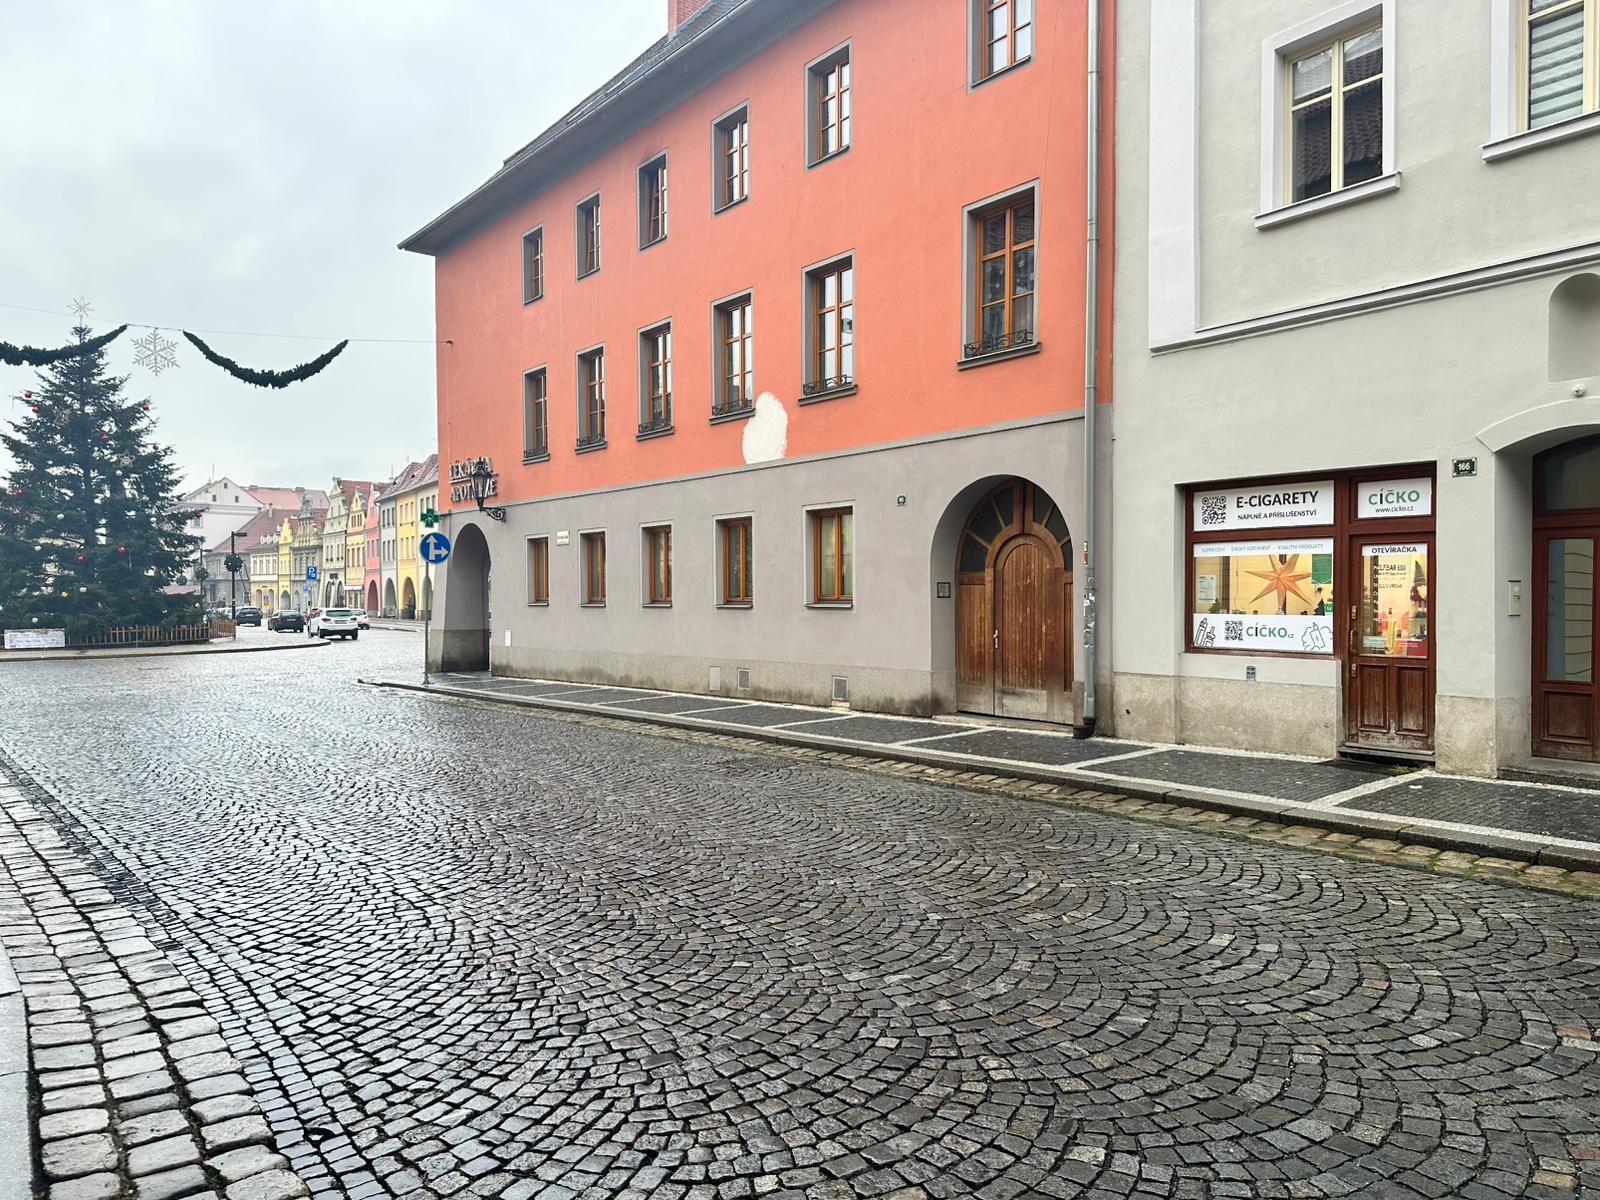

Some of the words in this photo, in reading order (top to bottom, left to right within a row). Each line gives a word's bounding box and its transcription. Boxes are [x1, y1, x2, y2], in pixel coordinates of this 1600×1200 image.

[1458, 462, 1470, 470] 166
[1236, 490, 1319, 508] E-CIGARETY
[1269, 509, 1317, 519] PŘÍSLUŠENSTVÍ
[1371, 546, 1418, 554] OTEVÍRAČKA
[308, 567, 315, 576] P
